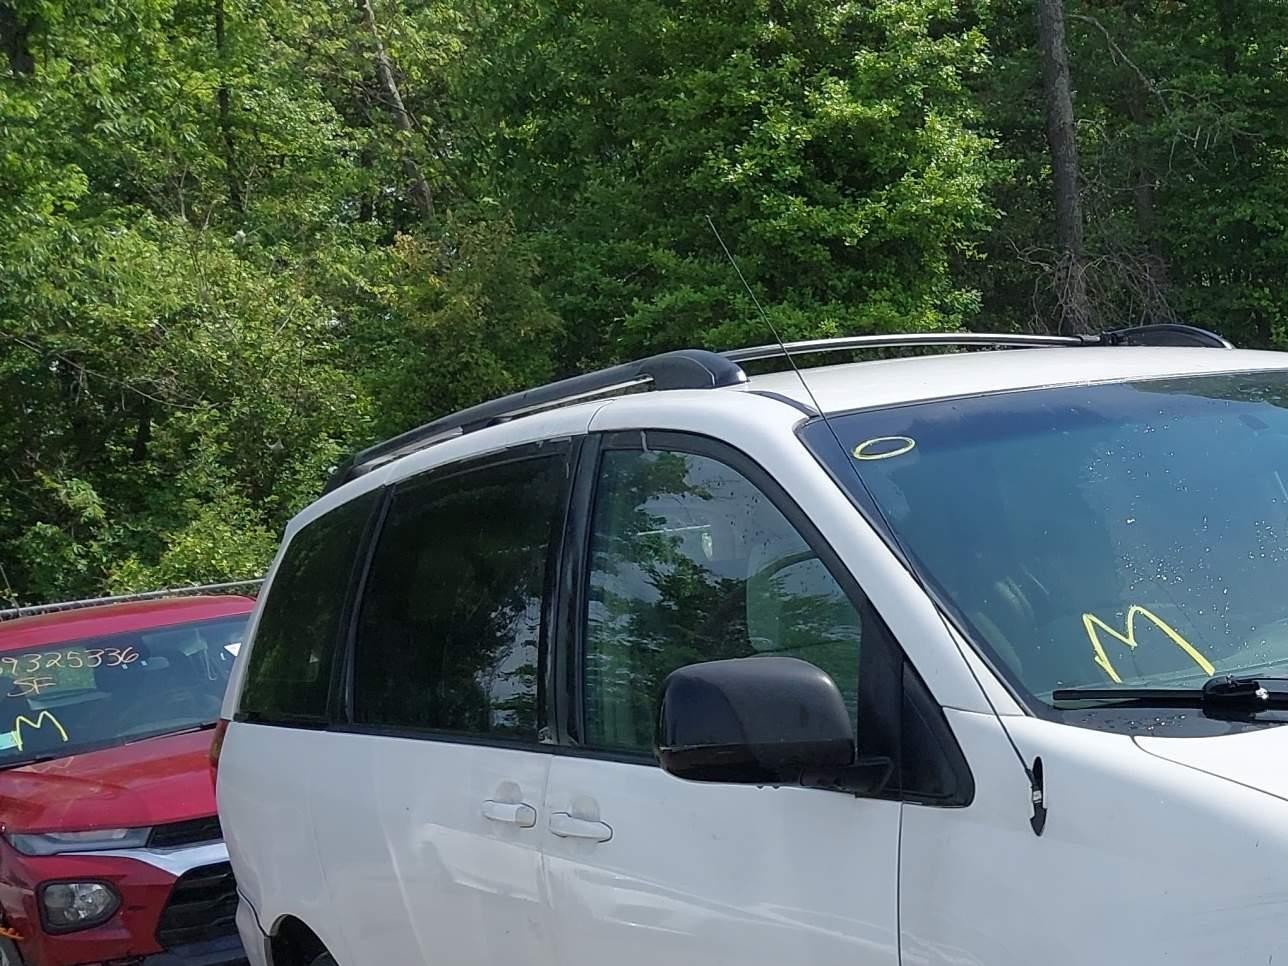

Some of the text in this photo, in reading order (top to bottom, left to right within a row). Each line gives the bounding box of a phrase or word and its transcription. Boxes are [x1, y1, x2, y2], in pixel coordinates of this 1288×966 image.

[0, 646, 140, 676] 9325336
[1081, 604, 1216, 684] M
[11, 710, 69, 752] M
